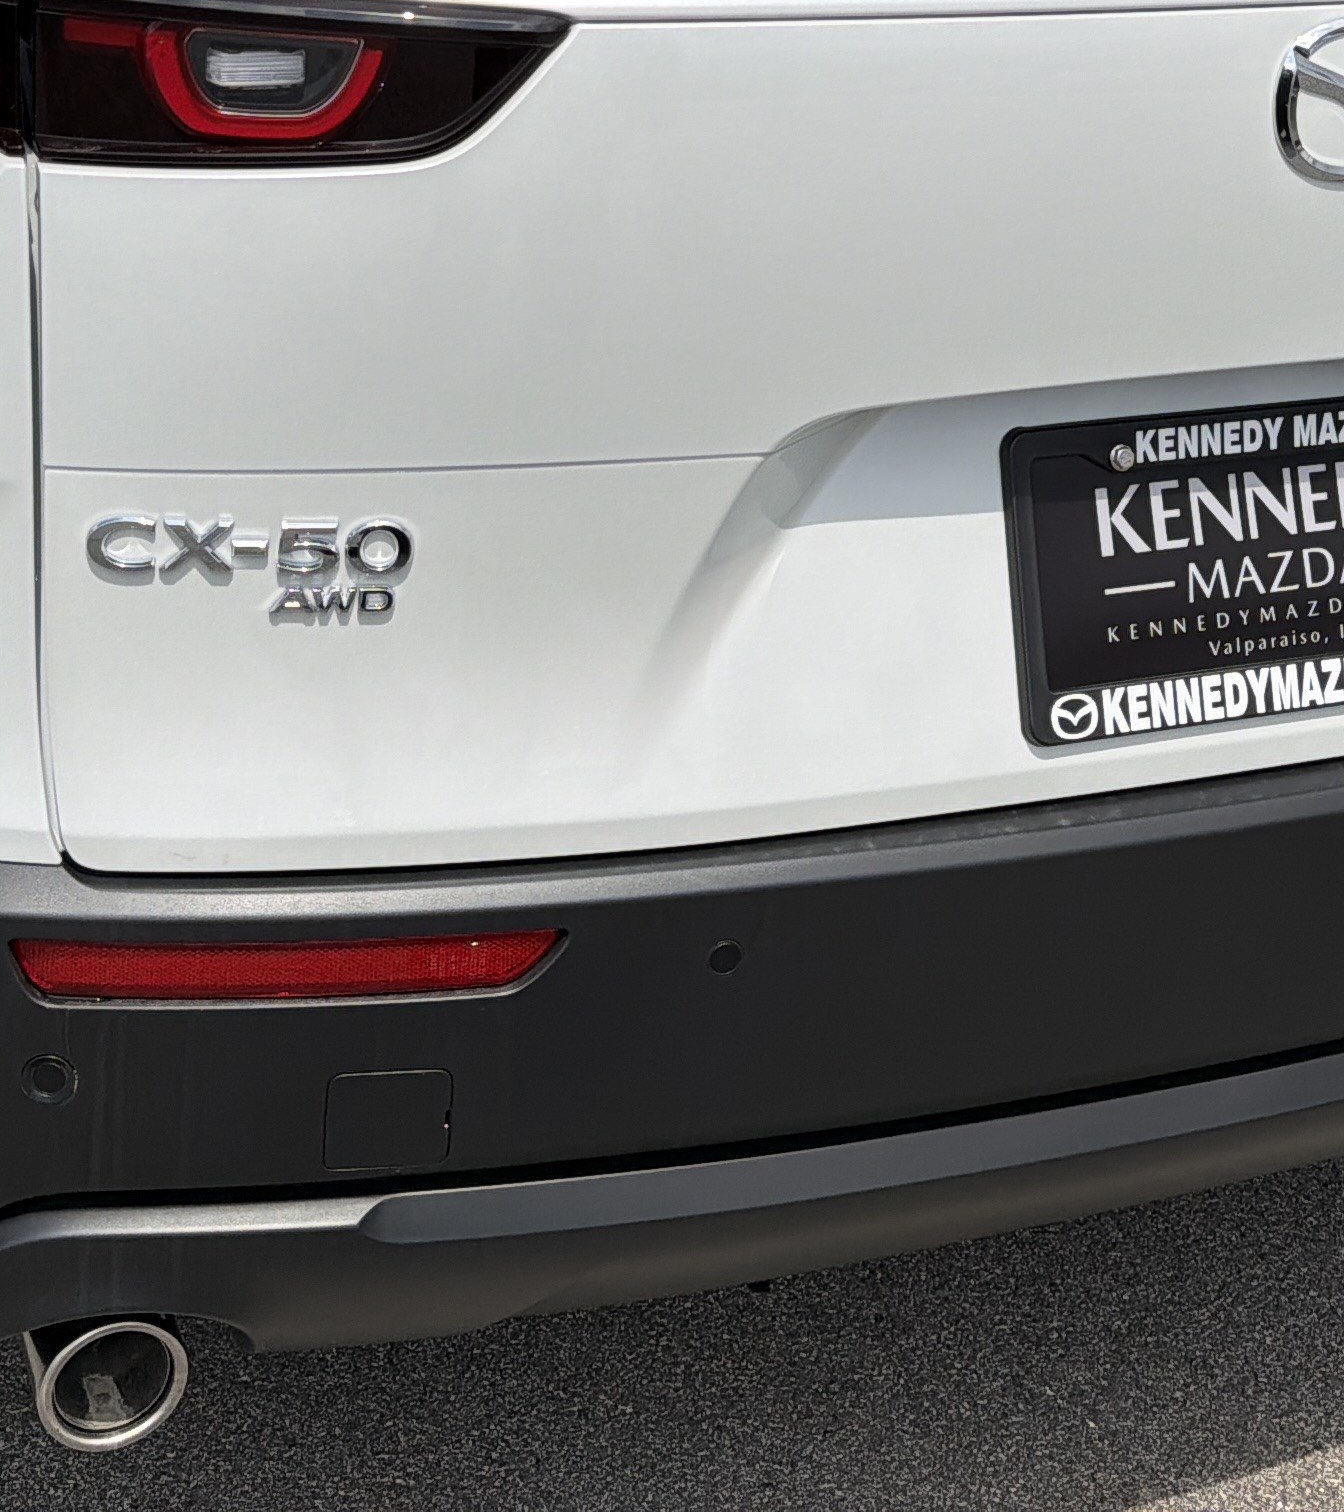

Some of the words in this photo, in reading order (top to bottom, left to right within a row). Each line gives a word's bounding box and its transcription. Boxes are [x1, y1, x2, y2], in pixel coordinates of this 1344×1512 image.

[1134, 415, 1282, 464] KENNEDY
[86, 514, 413, 576] CX-50
[268, 584, 396, 620] AWD
[1208, 629, 1331, 657] Valparaiso,
